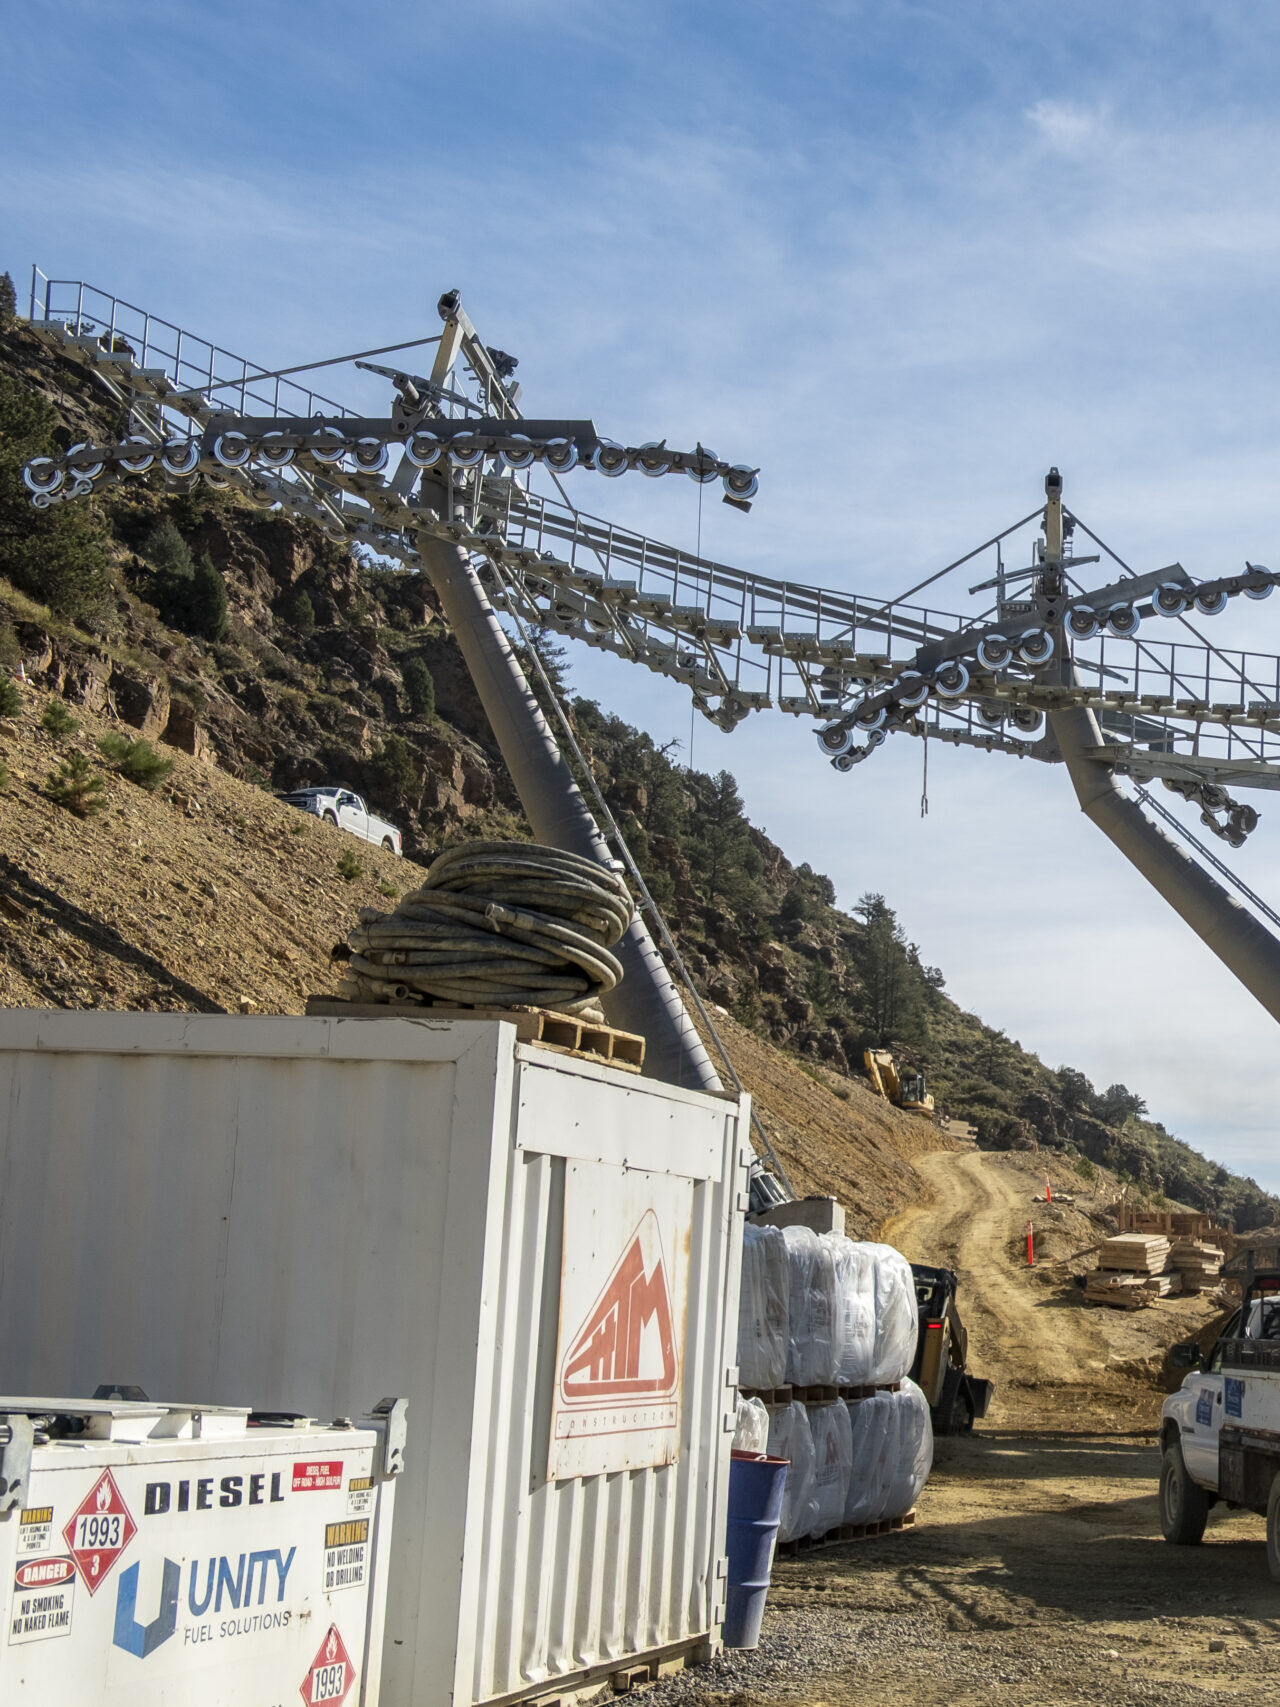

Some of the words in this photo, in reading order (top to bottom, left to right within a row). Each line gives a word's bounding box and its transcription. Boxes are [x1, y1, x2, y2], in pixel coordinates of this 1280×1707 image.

[558, 1411, 674, 1430] CONSTRUCTION
[144, 1472, 284, 1516] DIESEL
[80, 1516, 120, 1547] 1993
[327, 1521, 367, 1546] WARNING
[91, 1554, 100, 1576] 3
[327, 1551, 335, 1568] NO
[337, 1546, 364, 1566] WELDING
[23, 1563, 68, 1583] DANGER
[189, 1546, 297, 1617] UNITY
[336, 1566, 363, 1585] DRILLING
[21, 1600, 30, 1616] NO
[33, 1594, 64, 1613] SMOKING
[12, 1619, 22, 1635] NO
[24, 1615, 45, 1633] NAKED
[48, 1610, 70, 1627] FLAME
[184, 1625, 213, 1646] FUEL
[220, 1610, 292, 1638] SOLUTIONS
[315, 1664, 343, 1700] 1993
